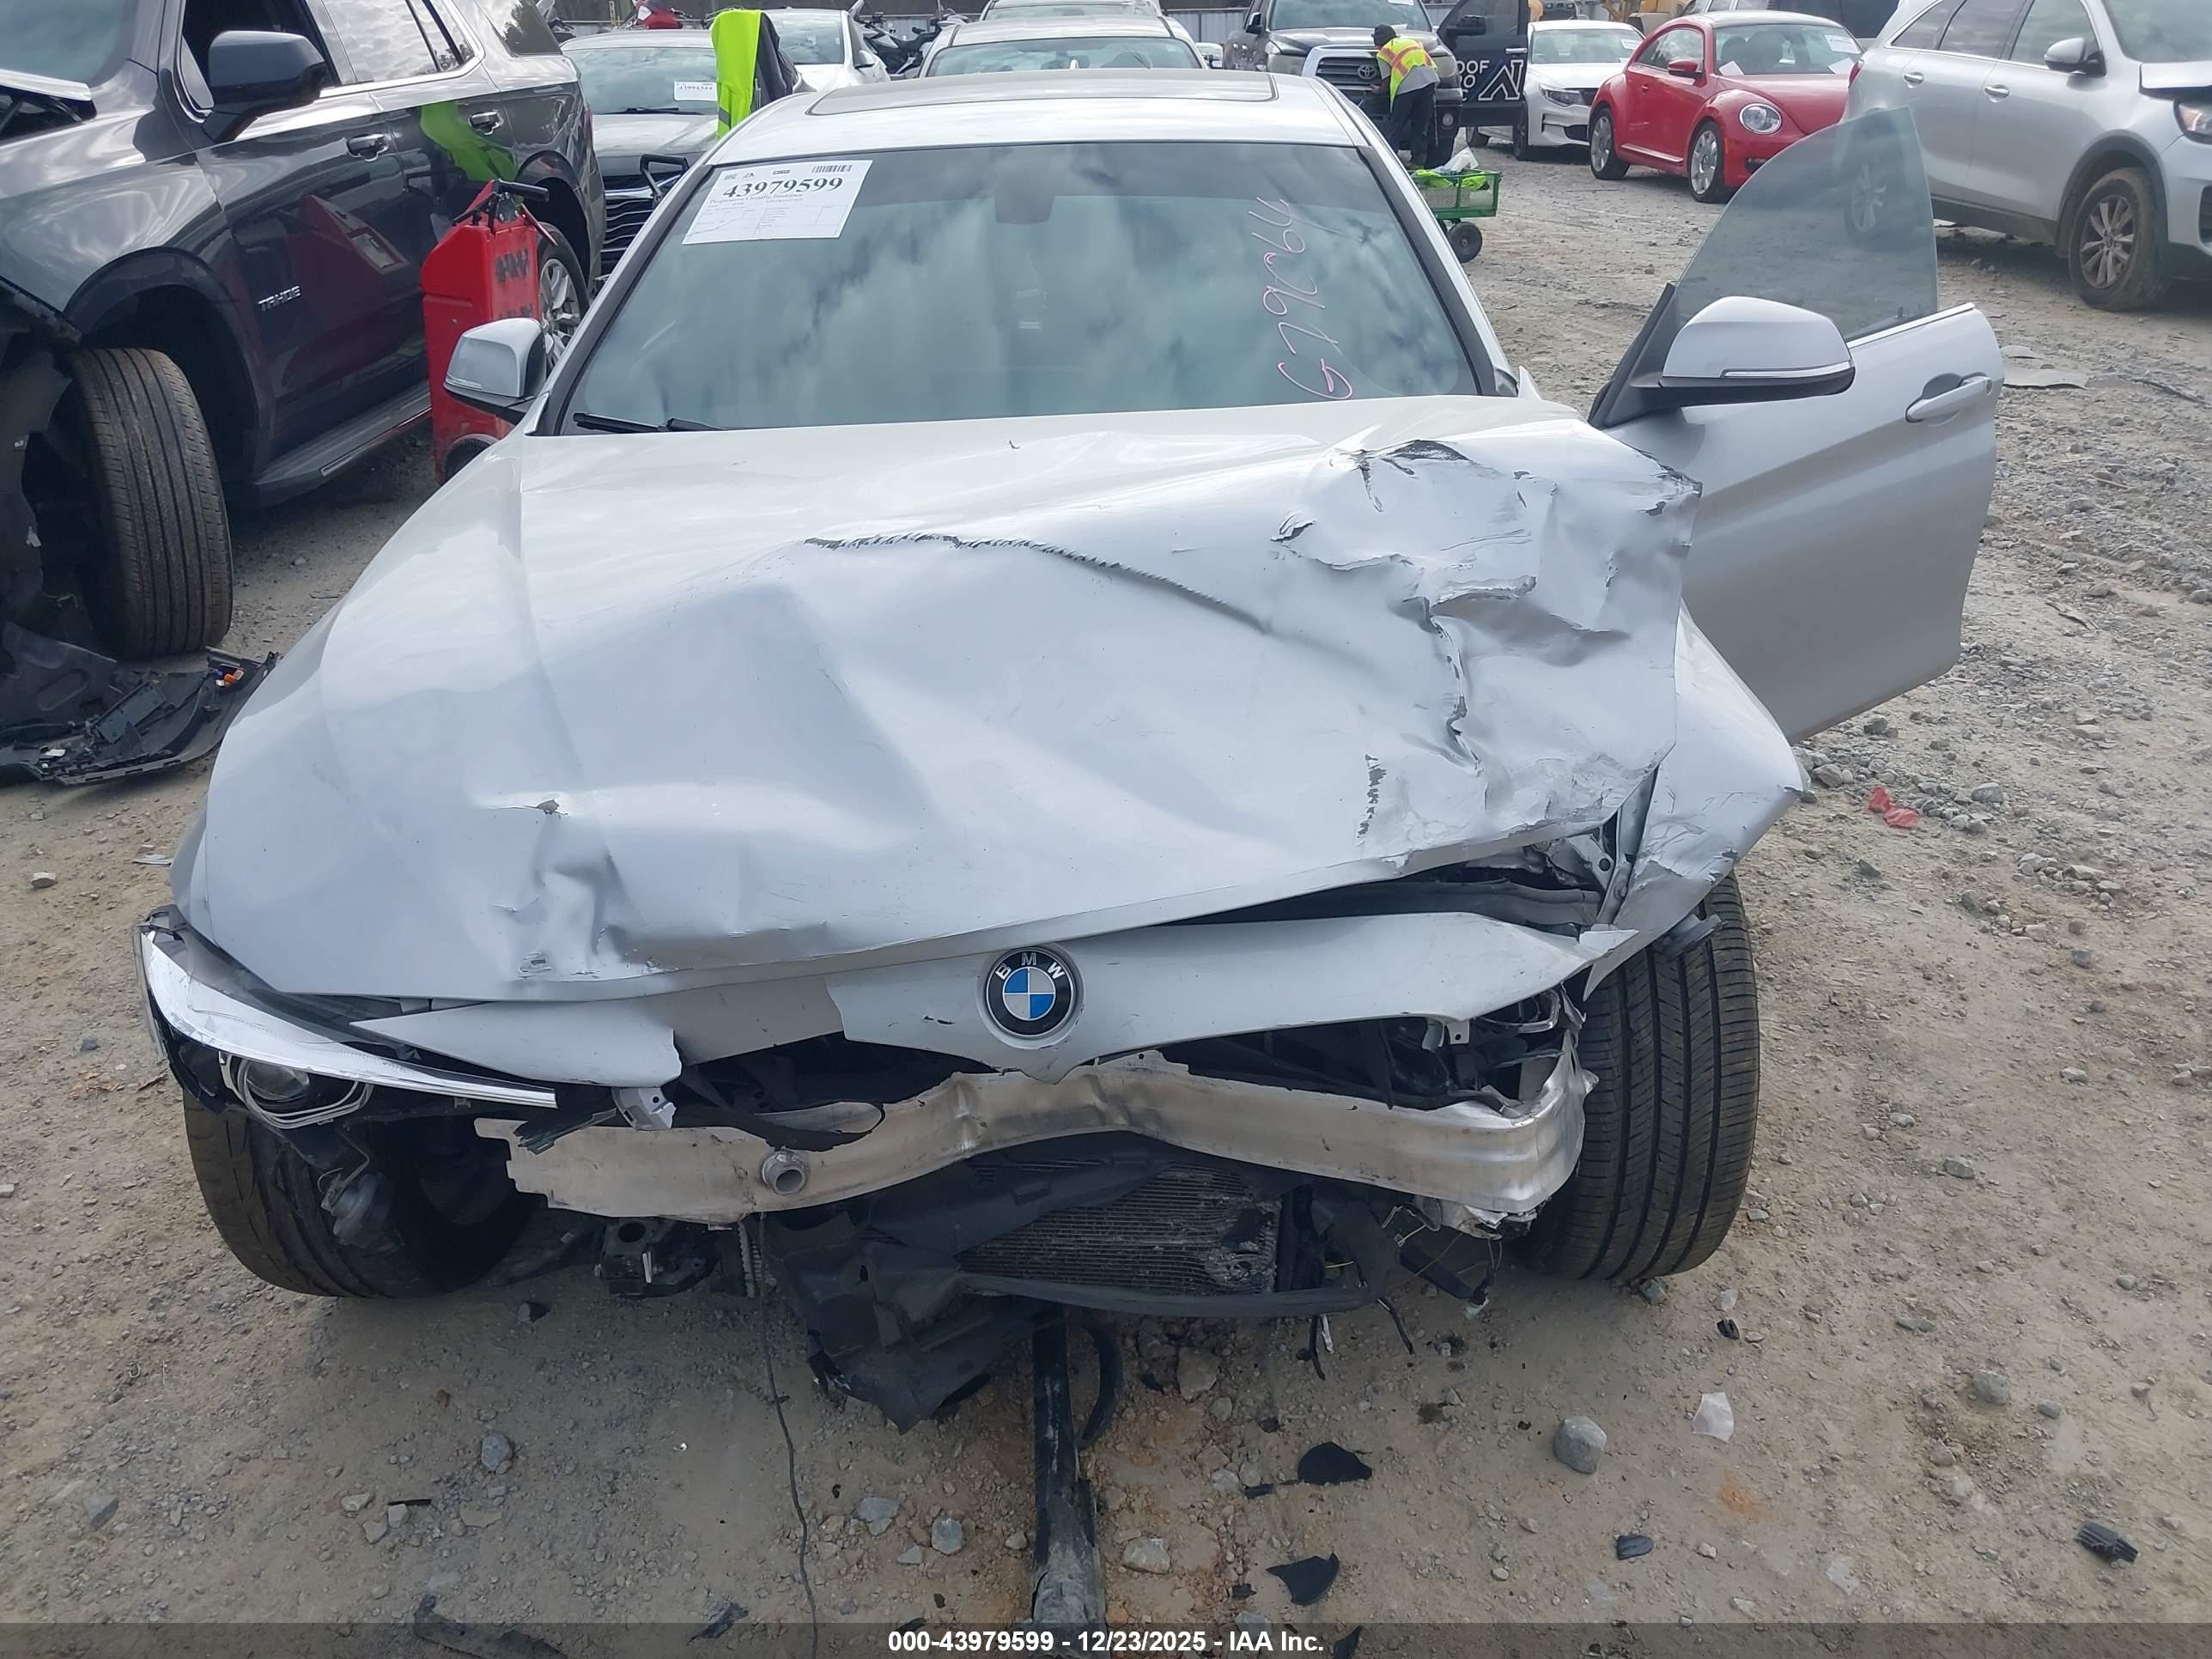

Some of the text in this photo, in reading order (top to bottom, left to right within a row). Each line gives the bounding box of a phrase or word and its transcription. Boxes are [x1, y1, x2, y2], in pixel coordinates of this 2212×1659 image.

[723, 177, 842, 198] 43979599
[258, 285, 302, 312] TAHOE
[994, 951, 1066, 981] BMW
